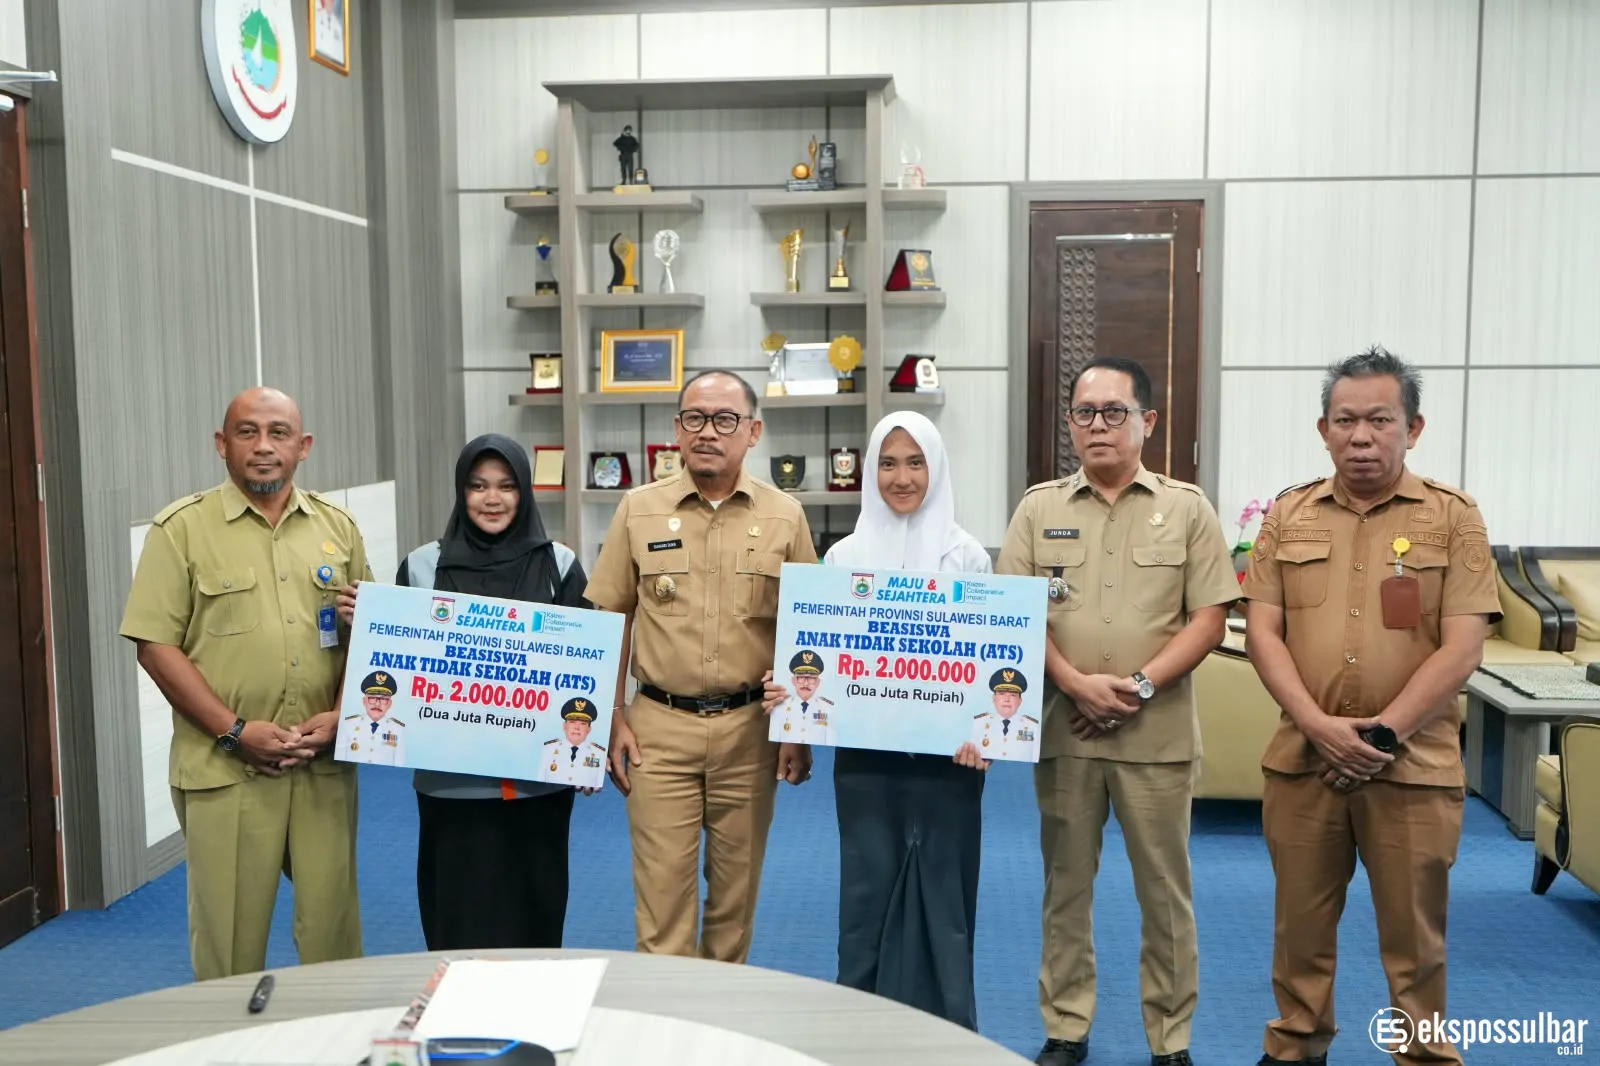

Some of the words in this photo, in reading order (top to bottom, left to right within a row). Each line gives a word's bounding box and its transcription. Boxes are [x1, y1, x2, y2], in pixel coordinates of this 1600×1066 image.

[887, 576, 924, 590] MAJU
[927, 579, 937, 590] &
[876, 589, 946, 604] SEJAHTERA
[468, 602, 506, 618] MAJU
[507, 607, 518, 620] &
[793, 602, 866, 618] PEMERINTAH
[869, 607, 924, 622] PROVINSI
[926, 611, 987, 625] SULAWESI
[990, 615, 1030, 628] BARAT
[456, 614, 526, 634] SEJAHTERA
[867, 620, 951, 638] BEASISWA
[369, 622, 445, 642] PEMERINTAH
[447, 631, 502, 649] PROVINSI
[504, 639, 563, 656] SULAWESI
[566, 646, 605, 661] BARAT
[795, 631, 842, 648] ANAK
[844, 635, 895, 652] TIDAK
[898, 639, 976, 658] SEKOLAH
[980, 643, 1024, 665] (ATS)
[444, 645, 528, 666] BEASISWA
[369, 651, 417, 670] ANAK
[419, 657, 471, 677] TIDAK
[475, 664, 551, 686] SEKOLAH
[554, 672, 596, 695] (ATS)
[837, 653, 870, 681] Rp.
[875, 655, 977, 685] 2.000.000
[411, 675, 444, 703] Rp.
[449, 680, 550, 712] 2.000.000
[846, 684, 877, 698] (Dua
[880, 686, 909, 700] Juta
[912, 688, 965, 706] Rupiah)
[418, 706, 449, 722] (Dua
[453, 710, 482, 724] Juta
[485, 715, 536, 733] Rupiah)
